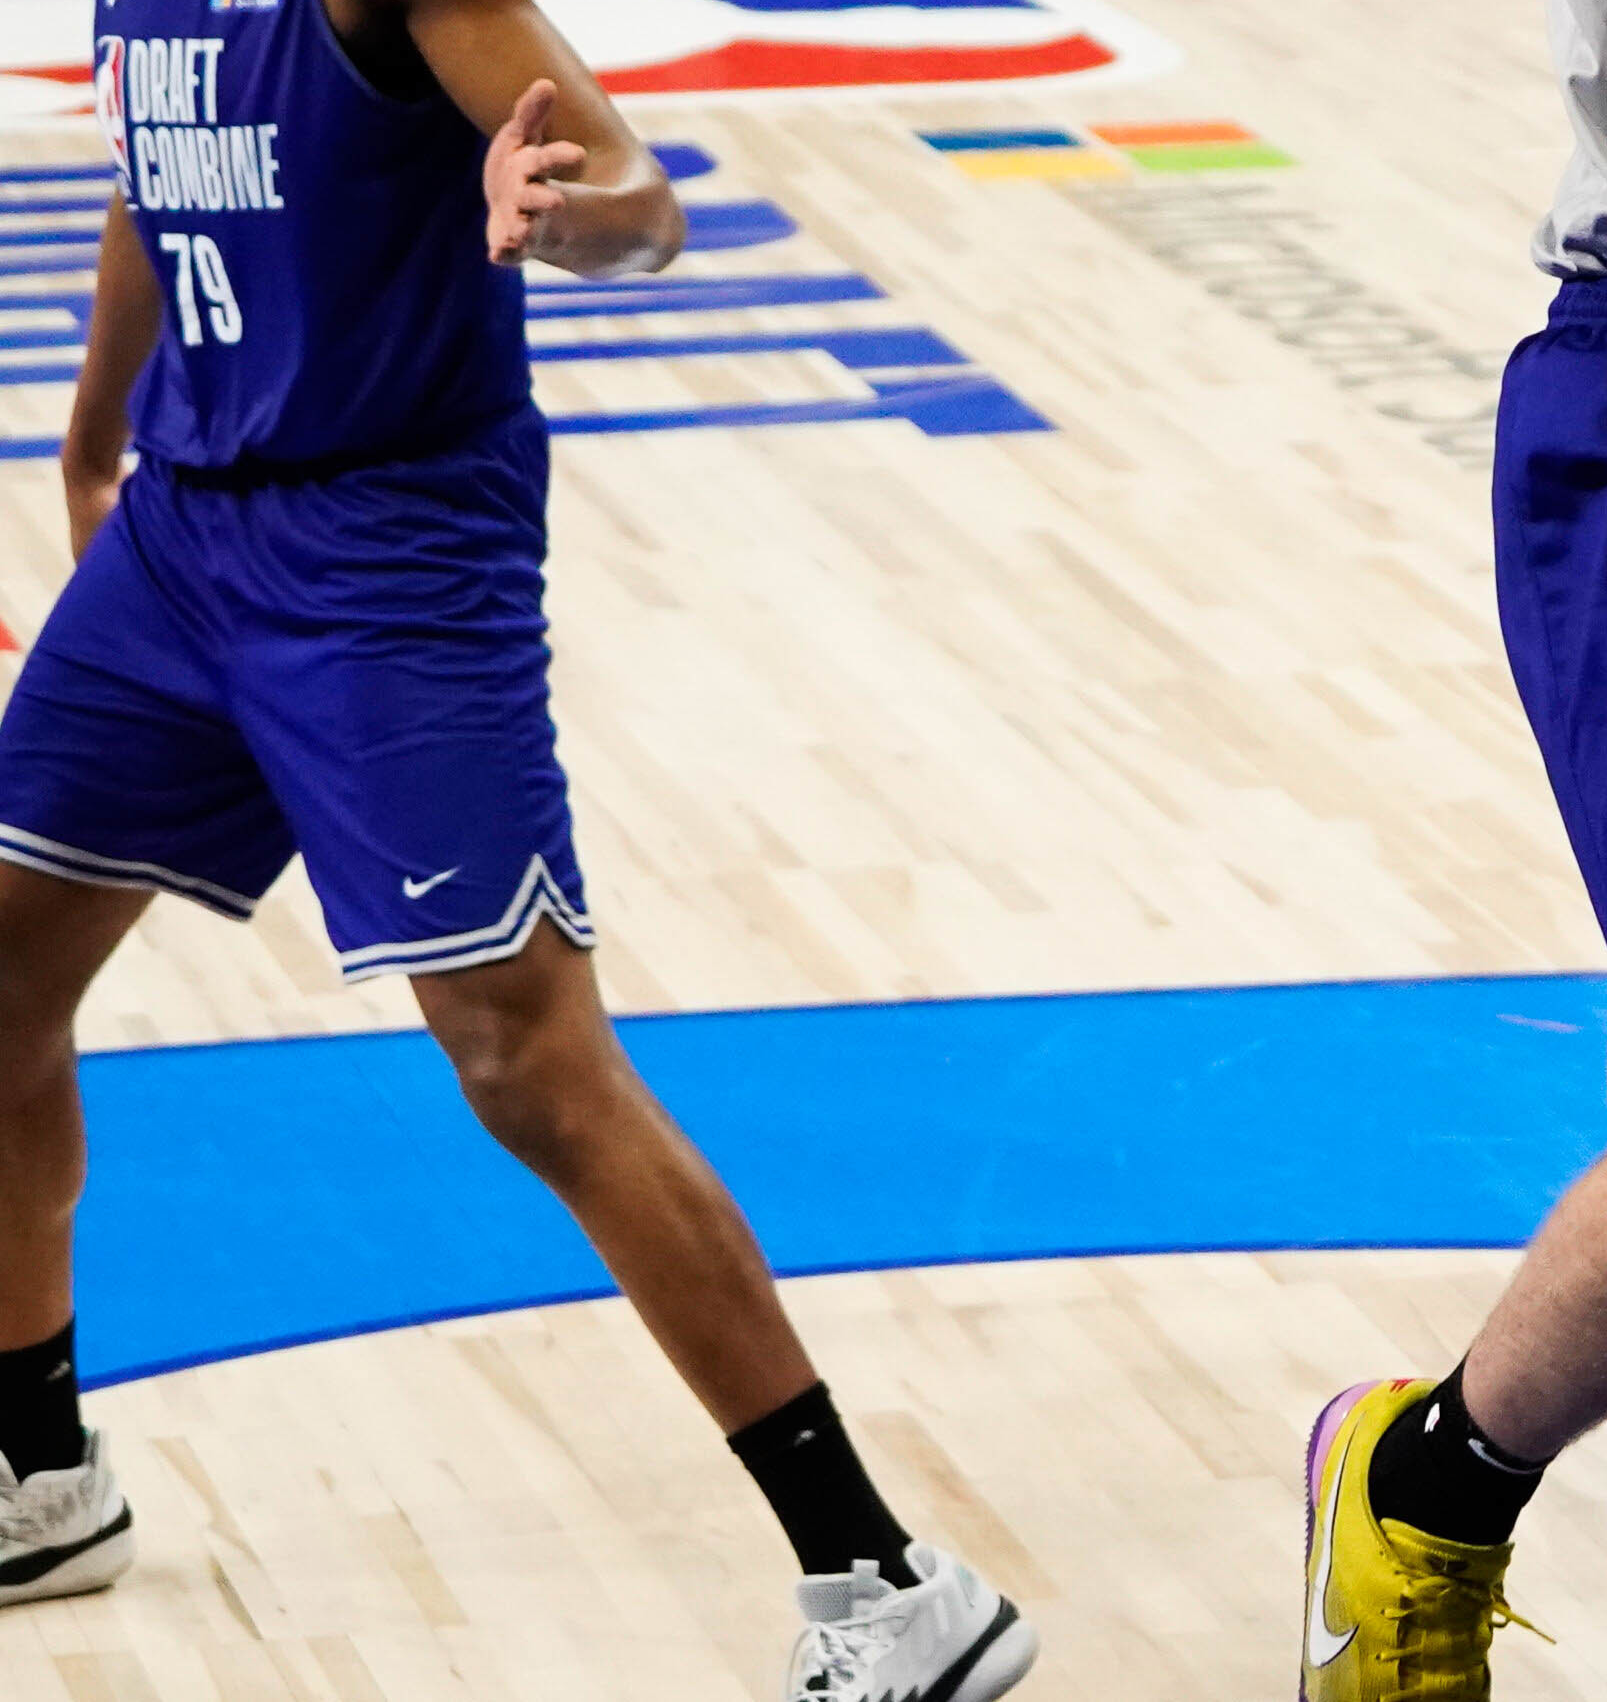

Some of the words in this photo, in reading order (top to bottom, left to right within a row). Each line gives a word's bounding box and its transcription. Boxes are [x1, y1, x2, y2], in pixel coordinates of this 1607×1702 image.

[129, 37, 225, 124] DRAFT
[133, 123, 285, 212] COMBINE
[160, 232, 243, 346] 79
